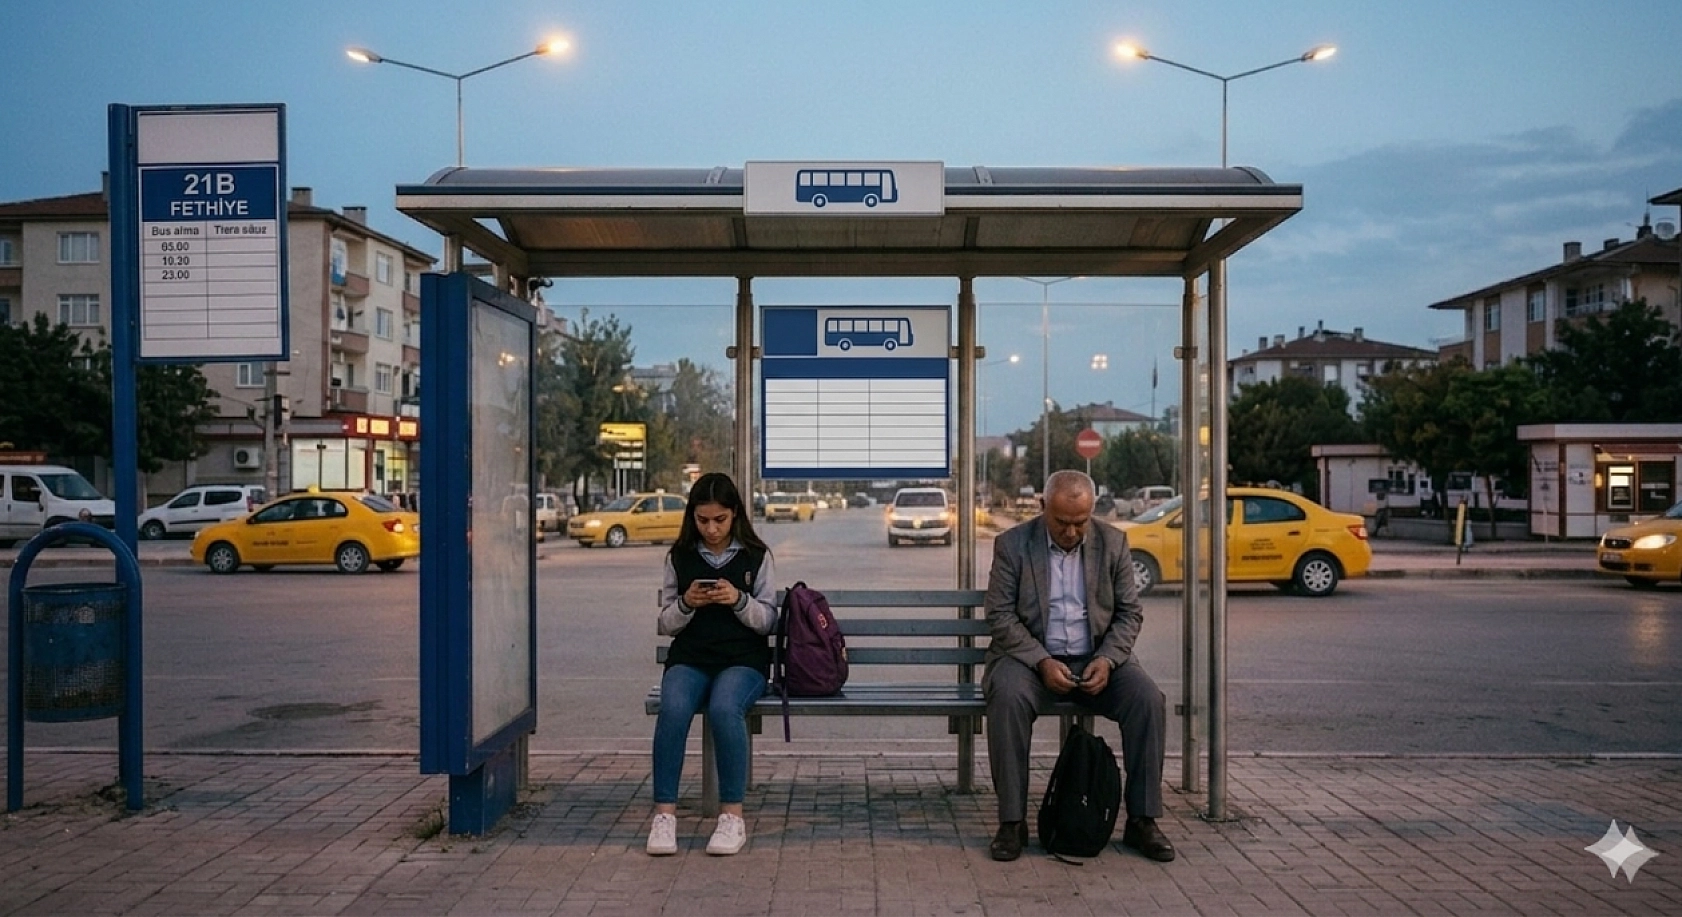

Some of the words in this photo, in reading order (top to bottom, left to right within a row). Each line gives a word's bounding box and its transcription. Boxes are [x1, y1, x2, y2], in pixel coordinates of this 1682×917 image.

[183, 173, 235, 195] 21B
[170, 197, 249, 216] FETHİYE
[151, 225, 171, 236] Bus
[173, 225, 200, 236] alma
[162, 255, 190, 266] 10.20
[161, 269, 190, 280] 23.00
